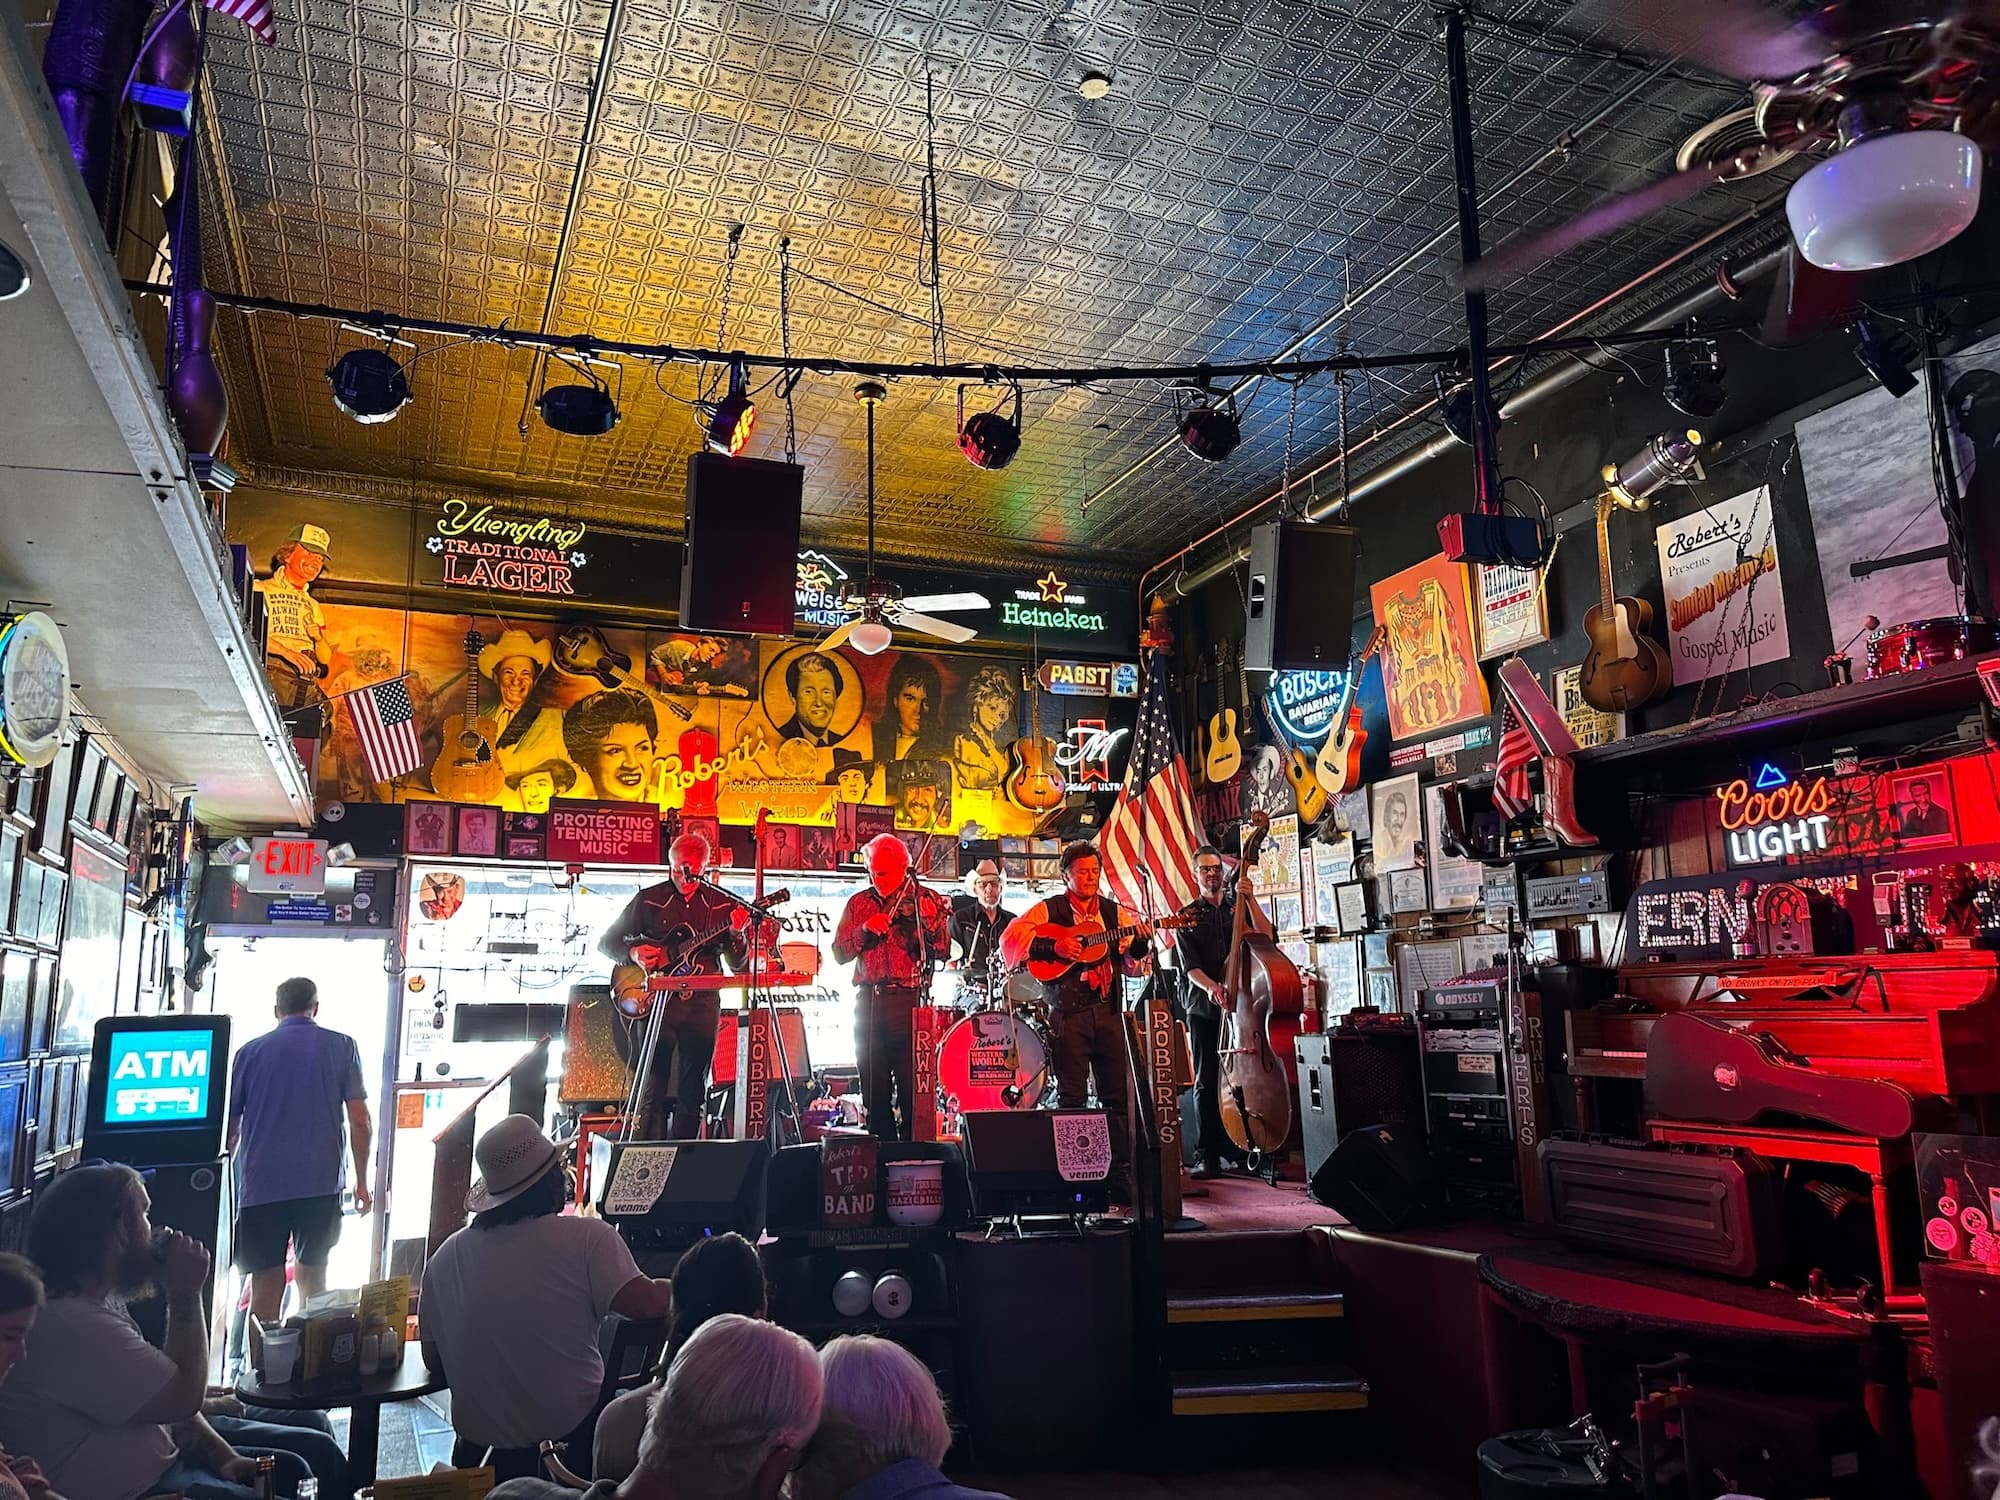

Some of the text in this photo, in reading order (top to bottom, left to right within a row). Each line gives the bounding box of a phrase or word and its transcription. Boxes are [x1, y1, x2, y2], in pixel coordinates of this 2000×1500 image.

[437, 499, 586, 550] Yuengling
[1667, 514, 1741, 558] Robert's
[444, 539, 570, 564] TRADITIONAL
[443, 555, 574, 594] LAGER
[1668, 555, 1710, 577] Presents
[804, 609, 850, 626] MUSIC
[1002, 602, 1105, 630] Heineken
[1670, 582, 1716, 633] Sunday
[1679, 612, 1777, 660] Gospel Music
[1050, 665, 1111, 686] PABST
[1288, 693, 1337, 720] BAVARIAN
[652, 726, 769, 806] Robert's
[739, 800, 808, 819] WRLD
[1716, 776, 1836, 830] Coors
[553, 813, 654, 830] PROTECTING
[555, 827, 653, 843] TENNESSEE
[579, 840, 629, 855] MUSIC
[1731, 815, 1829, 862] LIGHT
[264, 841, 316, 876] EXIT
[1446, 992, 1484, 1005] ODYSSEY
[972, 1036, 1011, 1048] Robert's
[1528, 1017, 1545, 1083] RWW
[113, 1049, 207, 1079] ATM
[916, 1030, 931, 1093] RWW
[972, 1057, 1004, 1066] WORLD
[1152, 1011, 1177, 1144] ROBERT'S
[1069, 1171, 1105, 1179] venmo
[614, 1204, 649, 1212] venmo
[824, 1193, 875, 1215] BAND
